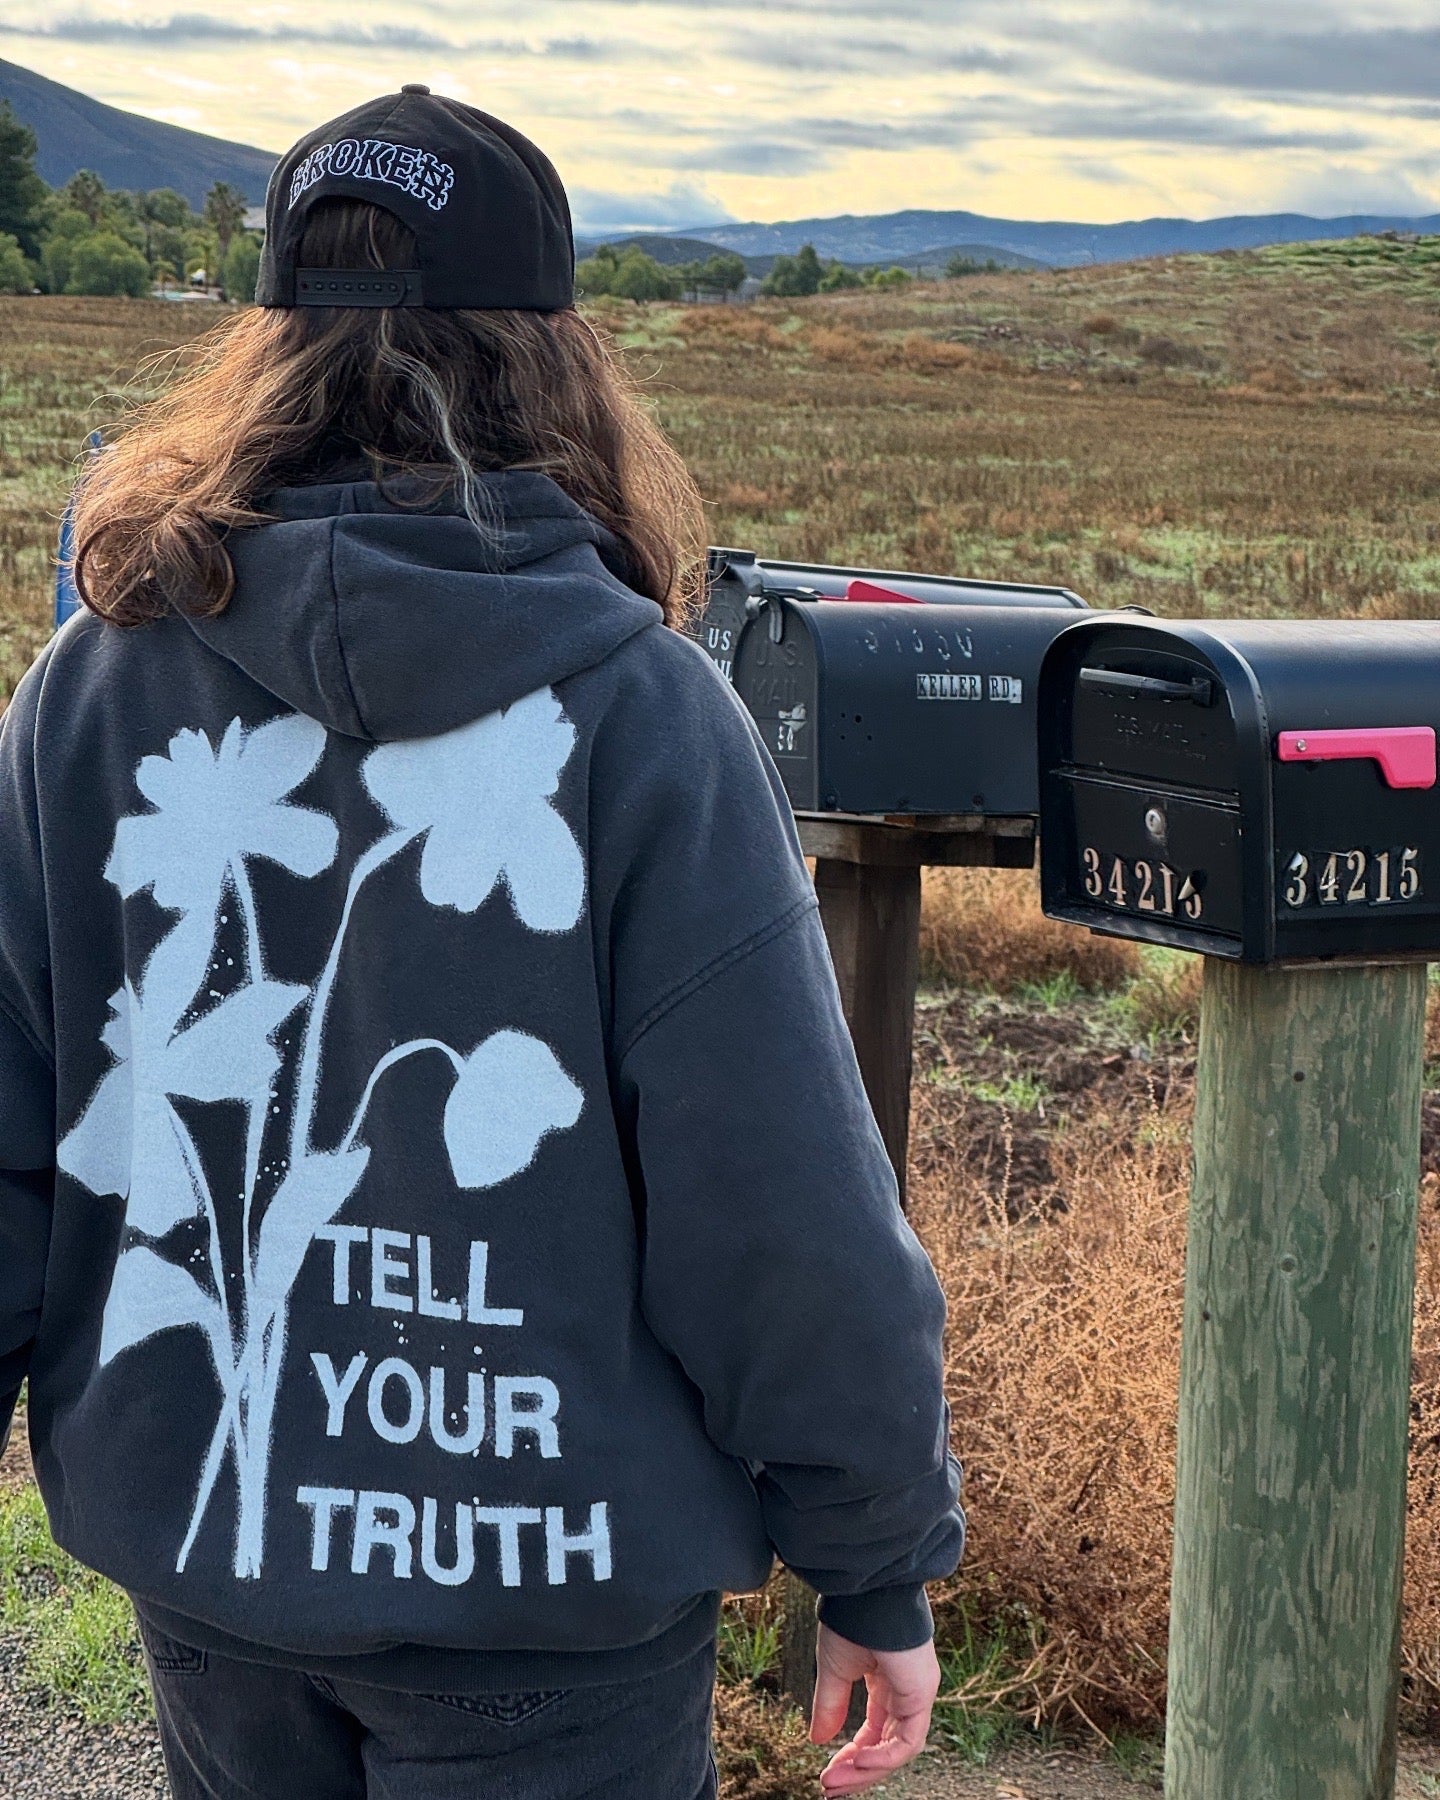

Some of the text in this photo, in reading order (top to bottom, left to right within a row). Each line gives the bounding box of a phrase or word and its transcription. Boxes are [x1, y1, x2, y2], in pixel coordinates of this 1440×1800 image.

[287, 138, 455, 211] BROKEN
[917, 675, 979, 698] KELLER
[1284, 847, 1420, 908] 34215
[315, 1223, 524, 1326] TELL
[310, 1352, 562, 1459] YOUR
[297, 1486, 613, 1587] TRUTH
